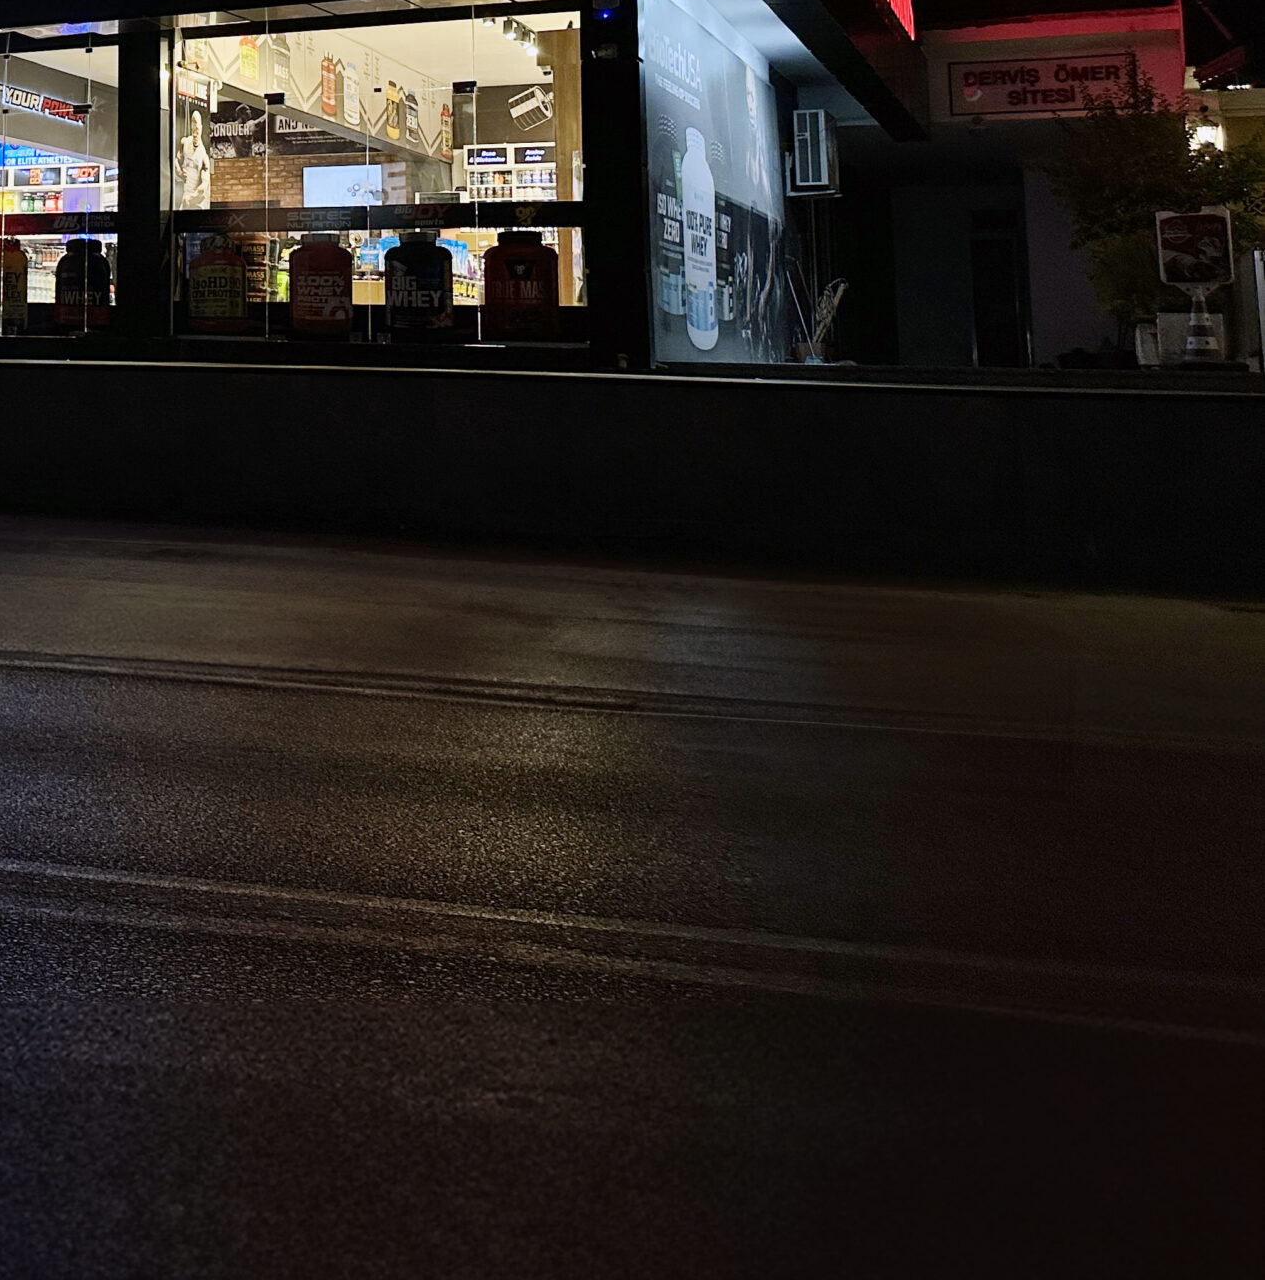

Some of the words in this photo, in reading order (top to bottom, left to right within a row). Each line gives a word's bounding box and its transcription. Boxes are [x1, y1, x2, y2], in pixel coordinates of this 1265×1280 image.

[1054, 64, 1121, 83] ÖMER
[4, 86, 40, 111] YOUR
[286, 211, 351, 220] SCITEC
[391, 275, 418, 291] BIG
[387, 290, 444, 308] WHEY
